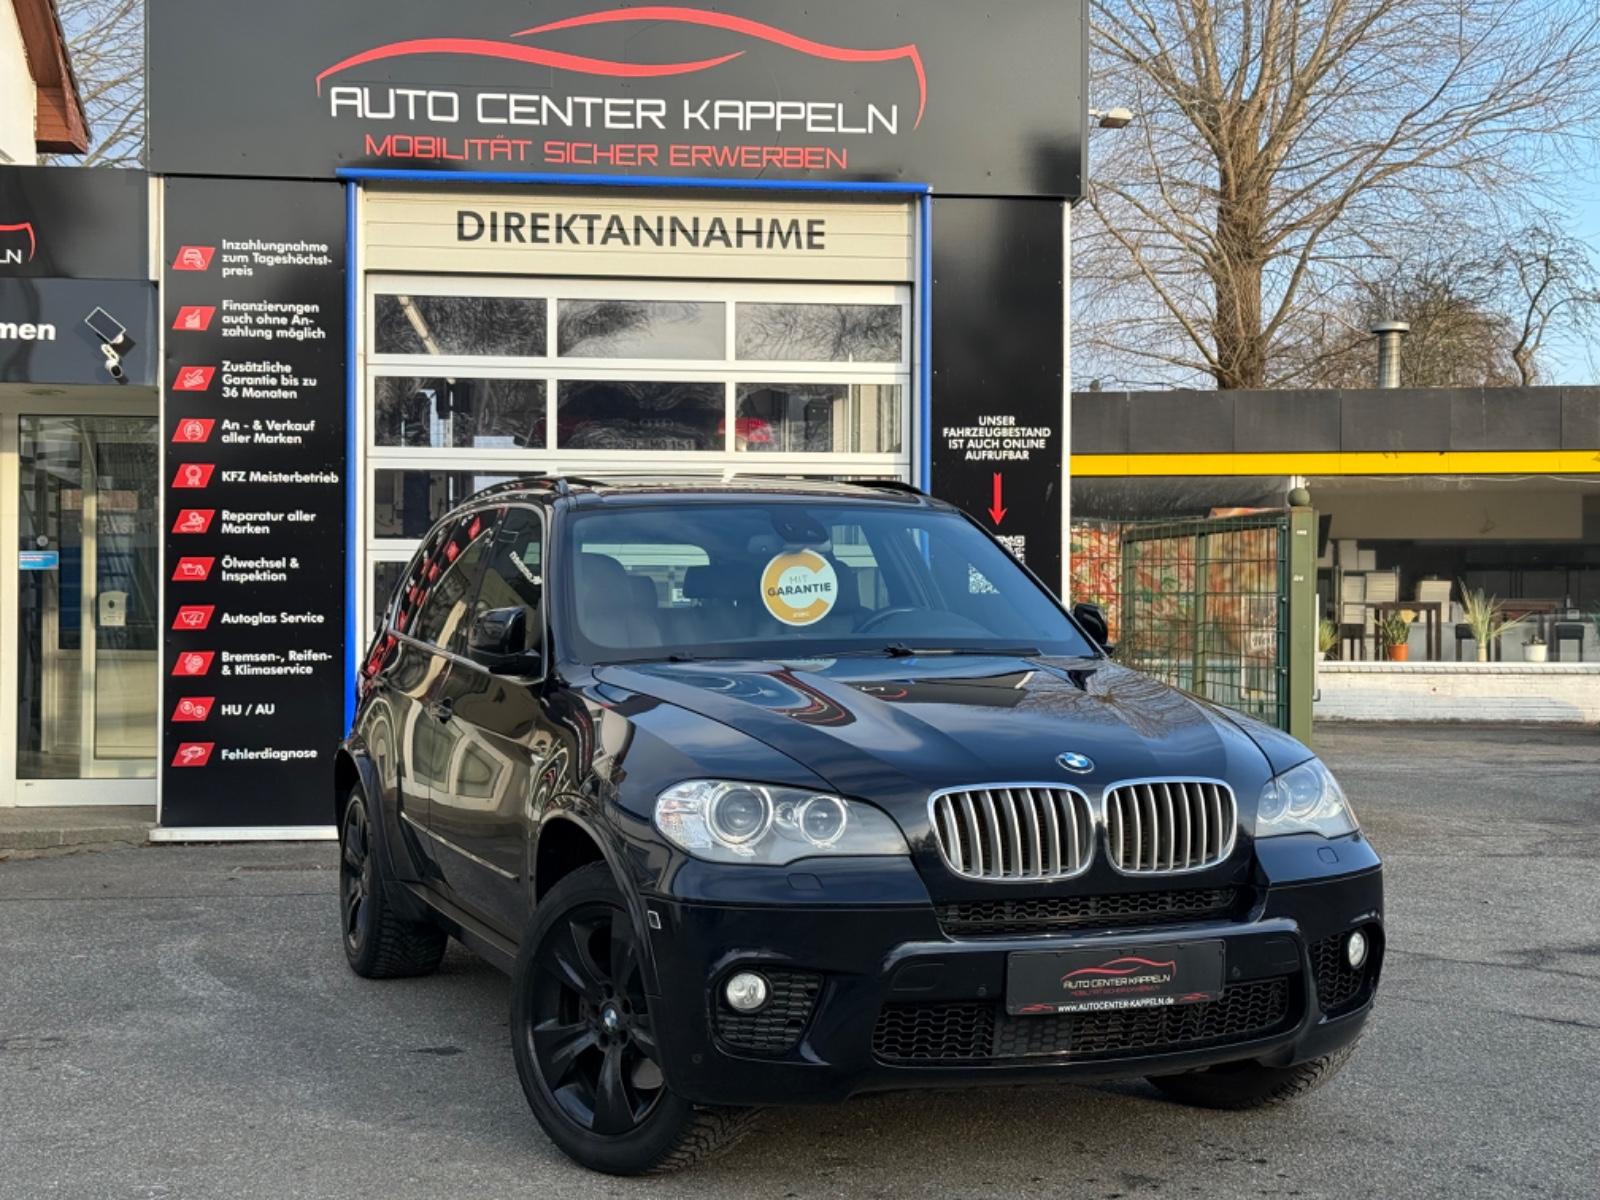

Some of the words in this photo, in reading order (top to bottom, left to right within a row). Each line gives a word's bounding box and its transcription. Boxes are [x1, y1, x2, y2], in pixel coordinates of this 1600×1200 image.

[330, 86, 459, 122] AUTO
[477, 93, 666, 129] CENTER
[684, 99, 897, 134] KAPPELN
[365, 134, 532, 161] MOBILITÄT
[543, 141, 658, 165] SICHER
[670, 144, 847, 169] ERWERBEN
[457, 210, 825, 250] DIREKTANNAHME
[222, 239, 329, 254] Inzahlungnahme
[222, 254, 249, 263] zum
[252, 252, 333, 266] Tageshöchst-
[222, 264, 253, 278] preis
[222, 300, 320, 314] Finanzierungen
[222, 313, 251, 324] auch
[256, 314, 288, 325] ohne
[291, 315, 315, 325] An-
[222, 326, 273, 340] zahlung
[276, 327, 326, 341] möglich
[222, 360, 292, 374] Zusätzliche
[222, 374, 278, 386] Garantie
[281, 375, 300, 387] bis
[302, 378, 318, 387] zu
[222, 387, 239, 398] 36
[242, 387, 298, 399] Monaten
[221, 419, 240, 430] An
[252, 420, 263, 431] &
[266, 420, 316, 432] Verkauf
[978, 415, 1015, 426] UNSER
[221, 432, 251, 443] aller
[254, 433, 302, 444] Marken
[942, 427, 1051, 438] FAHRZEUGBESTAND
[948, 438, 964, 449] IST
[967, 438, 1000, 449] AUCH
[1003, 438, 1046, 449] ONLINE
[965, 450, 1030, 460] AUFRUFBAR
[221, 471, 246, 482] KFZ
[250, 471, 339, 483] Meisterbetrieb
[221, 510, 284, 523] Reparatur
[287, 510, 317, 521] aller
[221, 523, 270, 534] Marken
[221, 555, 287, 568] Ölwechsel
[289, 558, 300, 569] &
[221, 570, 287, 584] Inspektion
[767, 582, 832, 597] GARANTIE
[221, 612, 277, 626] Autoglas
[280, 612, 324, 624] Service
[221, 651, 285, 663] Bremsen-,
[288, 650, 333, 662] Reifen-
[221, 664, 231, 676] &
[235, 663, 313, 675] Klimaservice
[221, 704, 242, 716] HU
[245, 704, 253, 716] /
[255, 703, 275, 715] AU
[221, 748, 318, 761] Fehlerdiagnose
[1063, 980, 1090, 990] AUTO
[1091, 977, 1127, 988] CENTER
[1128, 974, 1171, 985] KAPPELN
[1058, 996, 1174, 1012] www.AUTOCENTER-KAPPELN.de
